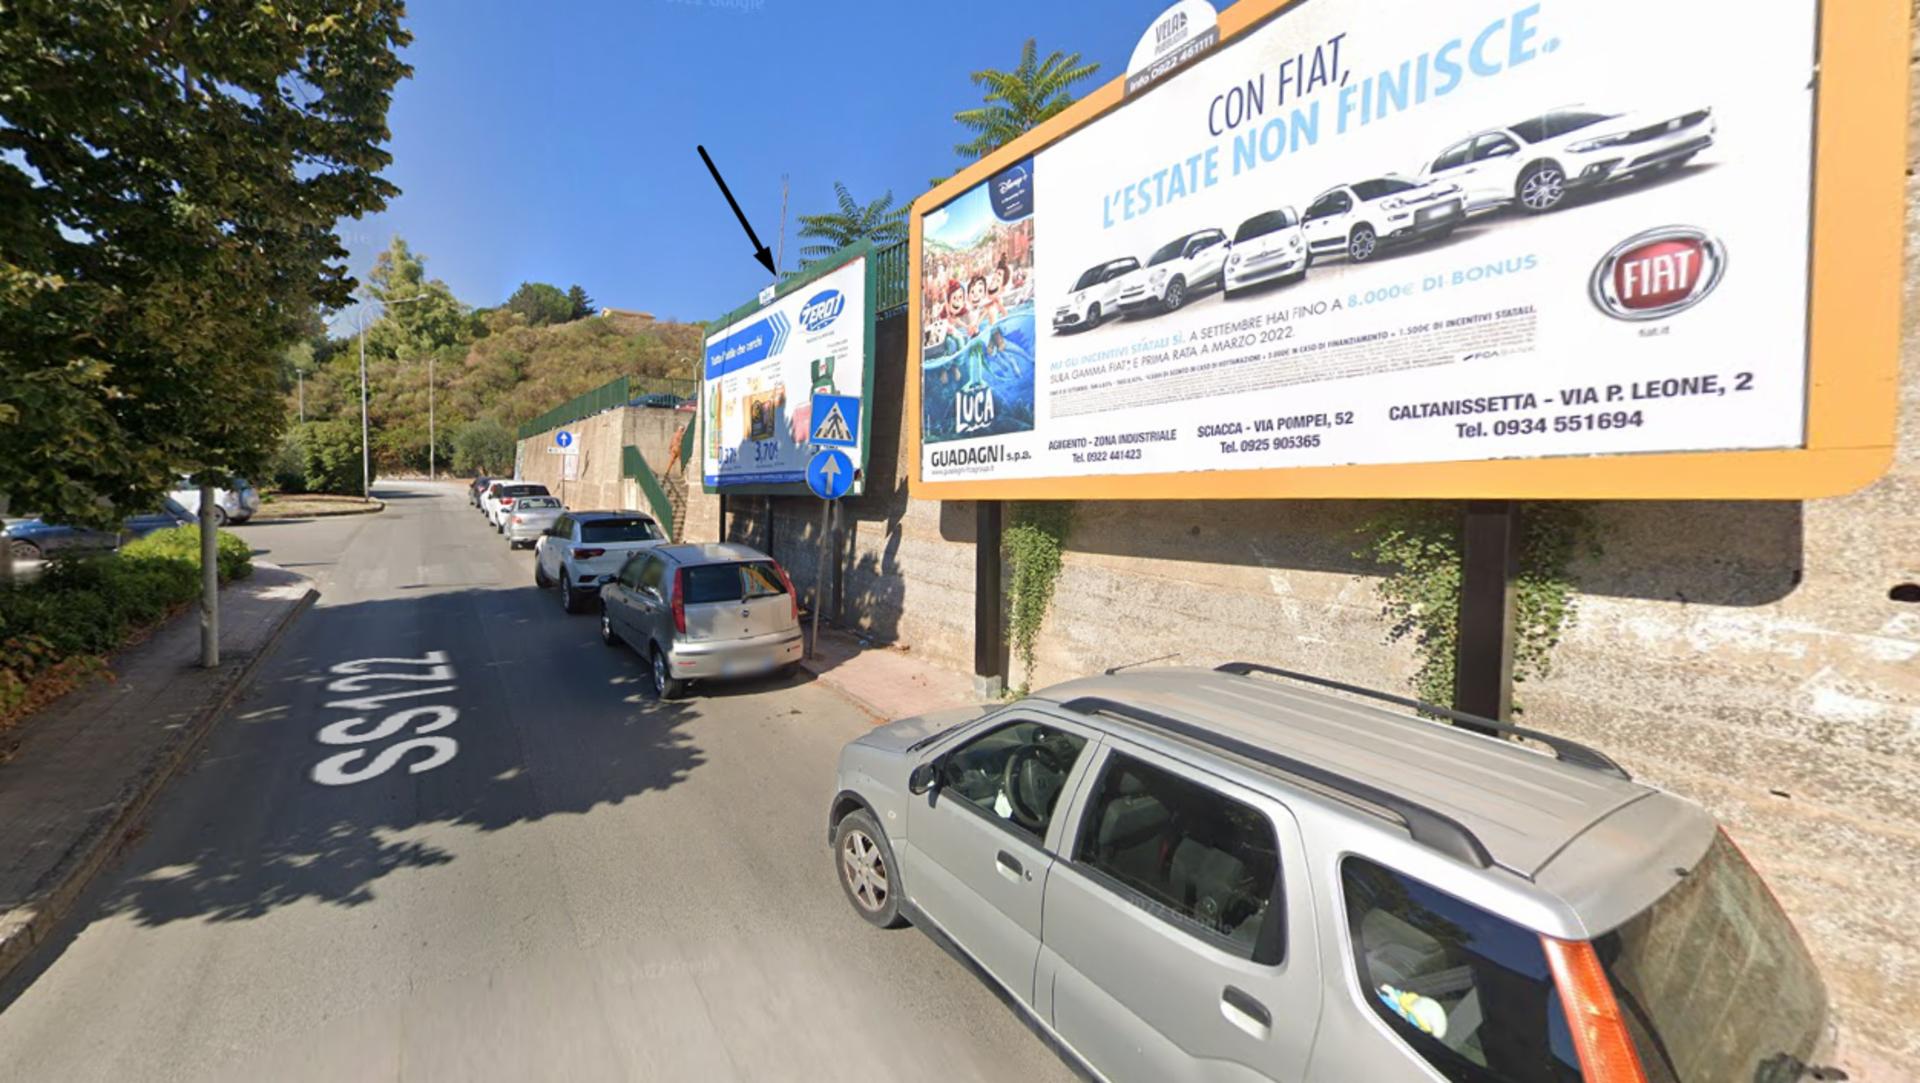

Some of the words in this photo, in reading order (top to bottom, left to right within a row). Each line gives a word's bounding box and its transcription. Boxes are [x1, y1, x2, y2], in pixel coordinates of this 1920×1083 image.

[1152, 56, 1178, 80] 0922
[1209, 74, 1265, 136] CON
[1278, 32, 1349, 106] FIAT,
[1103, 145, 1219, 230] L'ESTATE
[1232, 101, 1319, 176] NON
[1337, 2, 1560, 135] FINISCE.
[1623, 249, 1696, 299] FIAT
[1190, 331, 1198, 341] A
[1201, 316, 1262, 340] SETTEMBRE
[1266, 310, 1289, 325] HAI
[1293, 301, 1327, 320] FINO
[1331, 299, 1342, 311] A
[1348, 283, 1414, 308] 8.000€
[1422, 275, 1443, 291] DI
[1452, 255, 1537, 285] BONUS
[1432, 321, 1443, 330] DI
[1445, 313, 1492, 328] INCENTIVI
[1071, 366, 1106, 380] GAMMA
[1141, 352, 1169, 367] PRIMA
[1172, 347, 1197, 361] RATA
[1201, 344, 1210, 354] A
[1211, 334, 1257, 353] MARZO
[956, 388, 995, 433] LUCA
[1389, 392, 1537, 421] CALTANISSETTA
[1560, 387, 1599, 405] VIA
[1606, 384, 1623, 402] P.
[1632, 373, 1726, 400] LEONE,
[1734, 371, 1754, 391] 2
[1094, 434, 1117, 447] ZONA
[1118, 429, 1177, 445] INDUSTRIALE
[1197, 422, 1242, 438] SCIACCA
[1253, 419, 1274, 432] VIA
[1277, 412, 1331, 430] POMPEI,
[1335, 411, 1354, 426] 52
[1455, 422, 1488, 439] Tel.
[1493, 418, 1547, 437] 0934
[1554, 410, 1644, 433] 551694
[931, 444, 1004, 467] GUADAGNI
[1006, 451, 1032, 462] s.p.a.
[1087, 451, 1107, 462] 0922
[1110, 448, 1142, 461] 441423
[1220, 441, 1237, 454] Tel.
[1240, 438, 1269, 452] 0925
[1272, 434, 1320, 450] 905365
[311, 650, 459, 786] SS122
